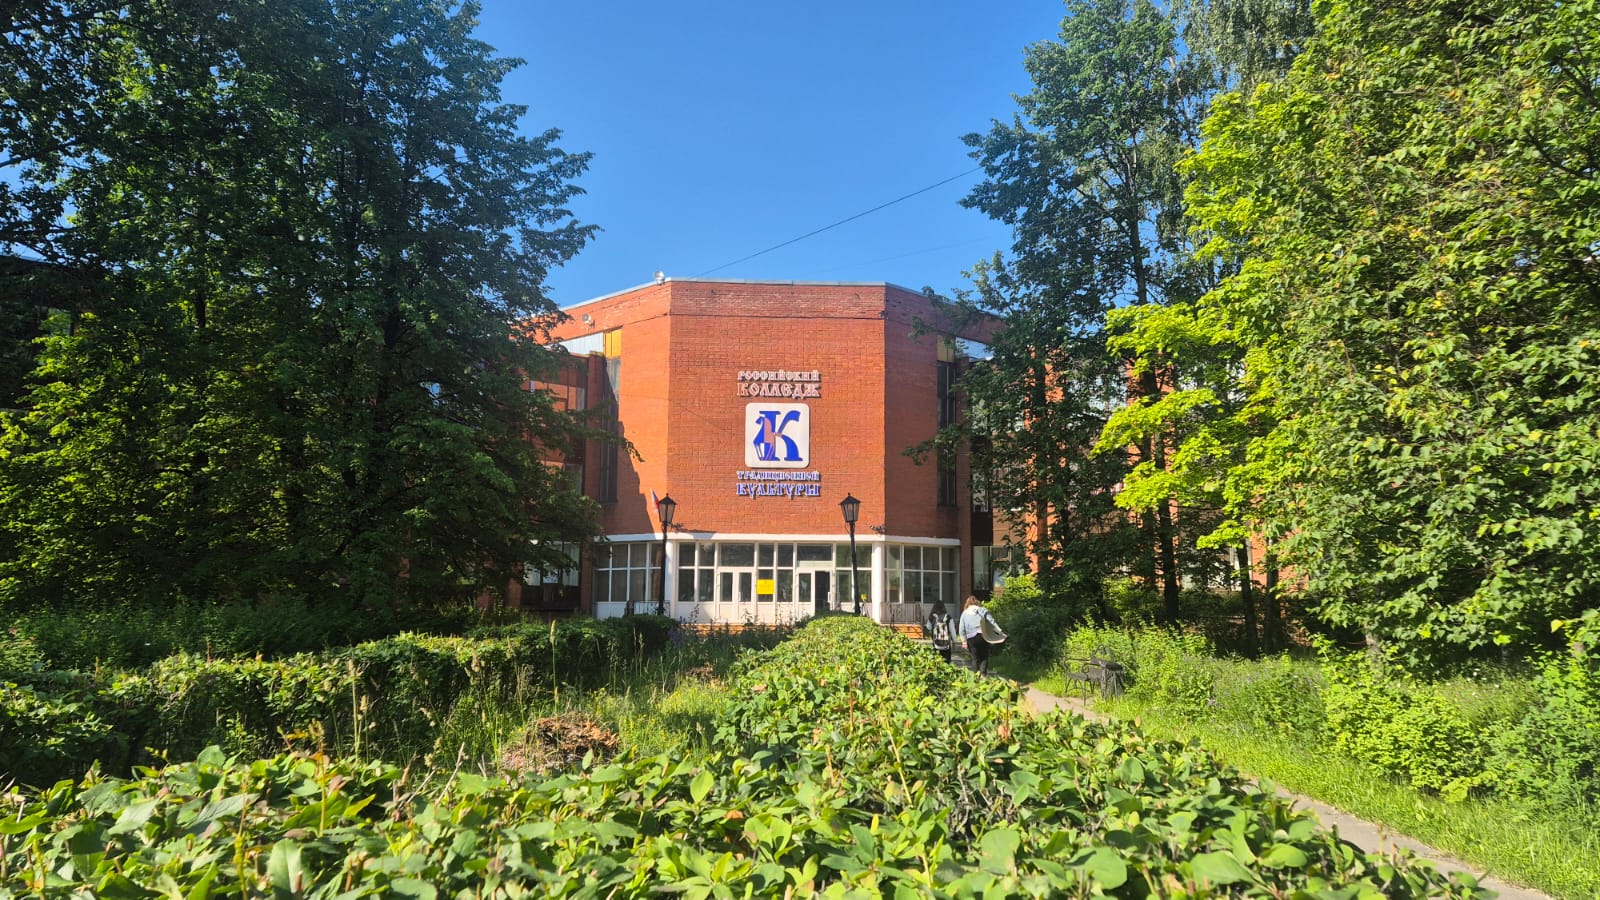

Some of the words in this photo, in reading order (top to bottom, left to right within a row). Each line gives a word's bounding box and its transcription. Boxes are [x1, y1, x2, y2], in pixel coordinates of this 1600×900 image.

[737, 369, 820, 381] РОССИЙСКИЙ
[737, 382, 820, 399] КОЛЛЕДЖ
[736, 482, 820, 499] КУЛЬТУРЫ
